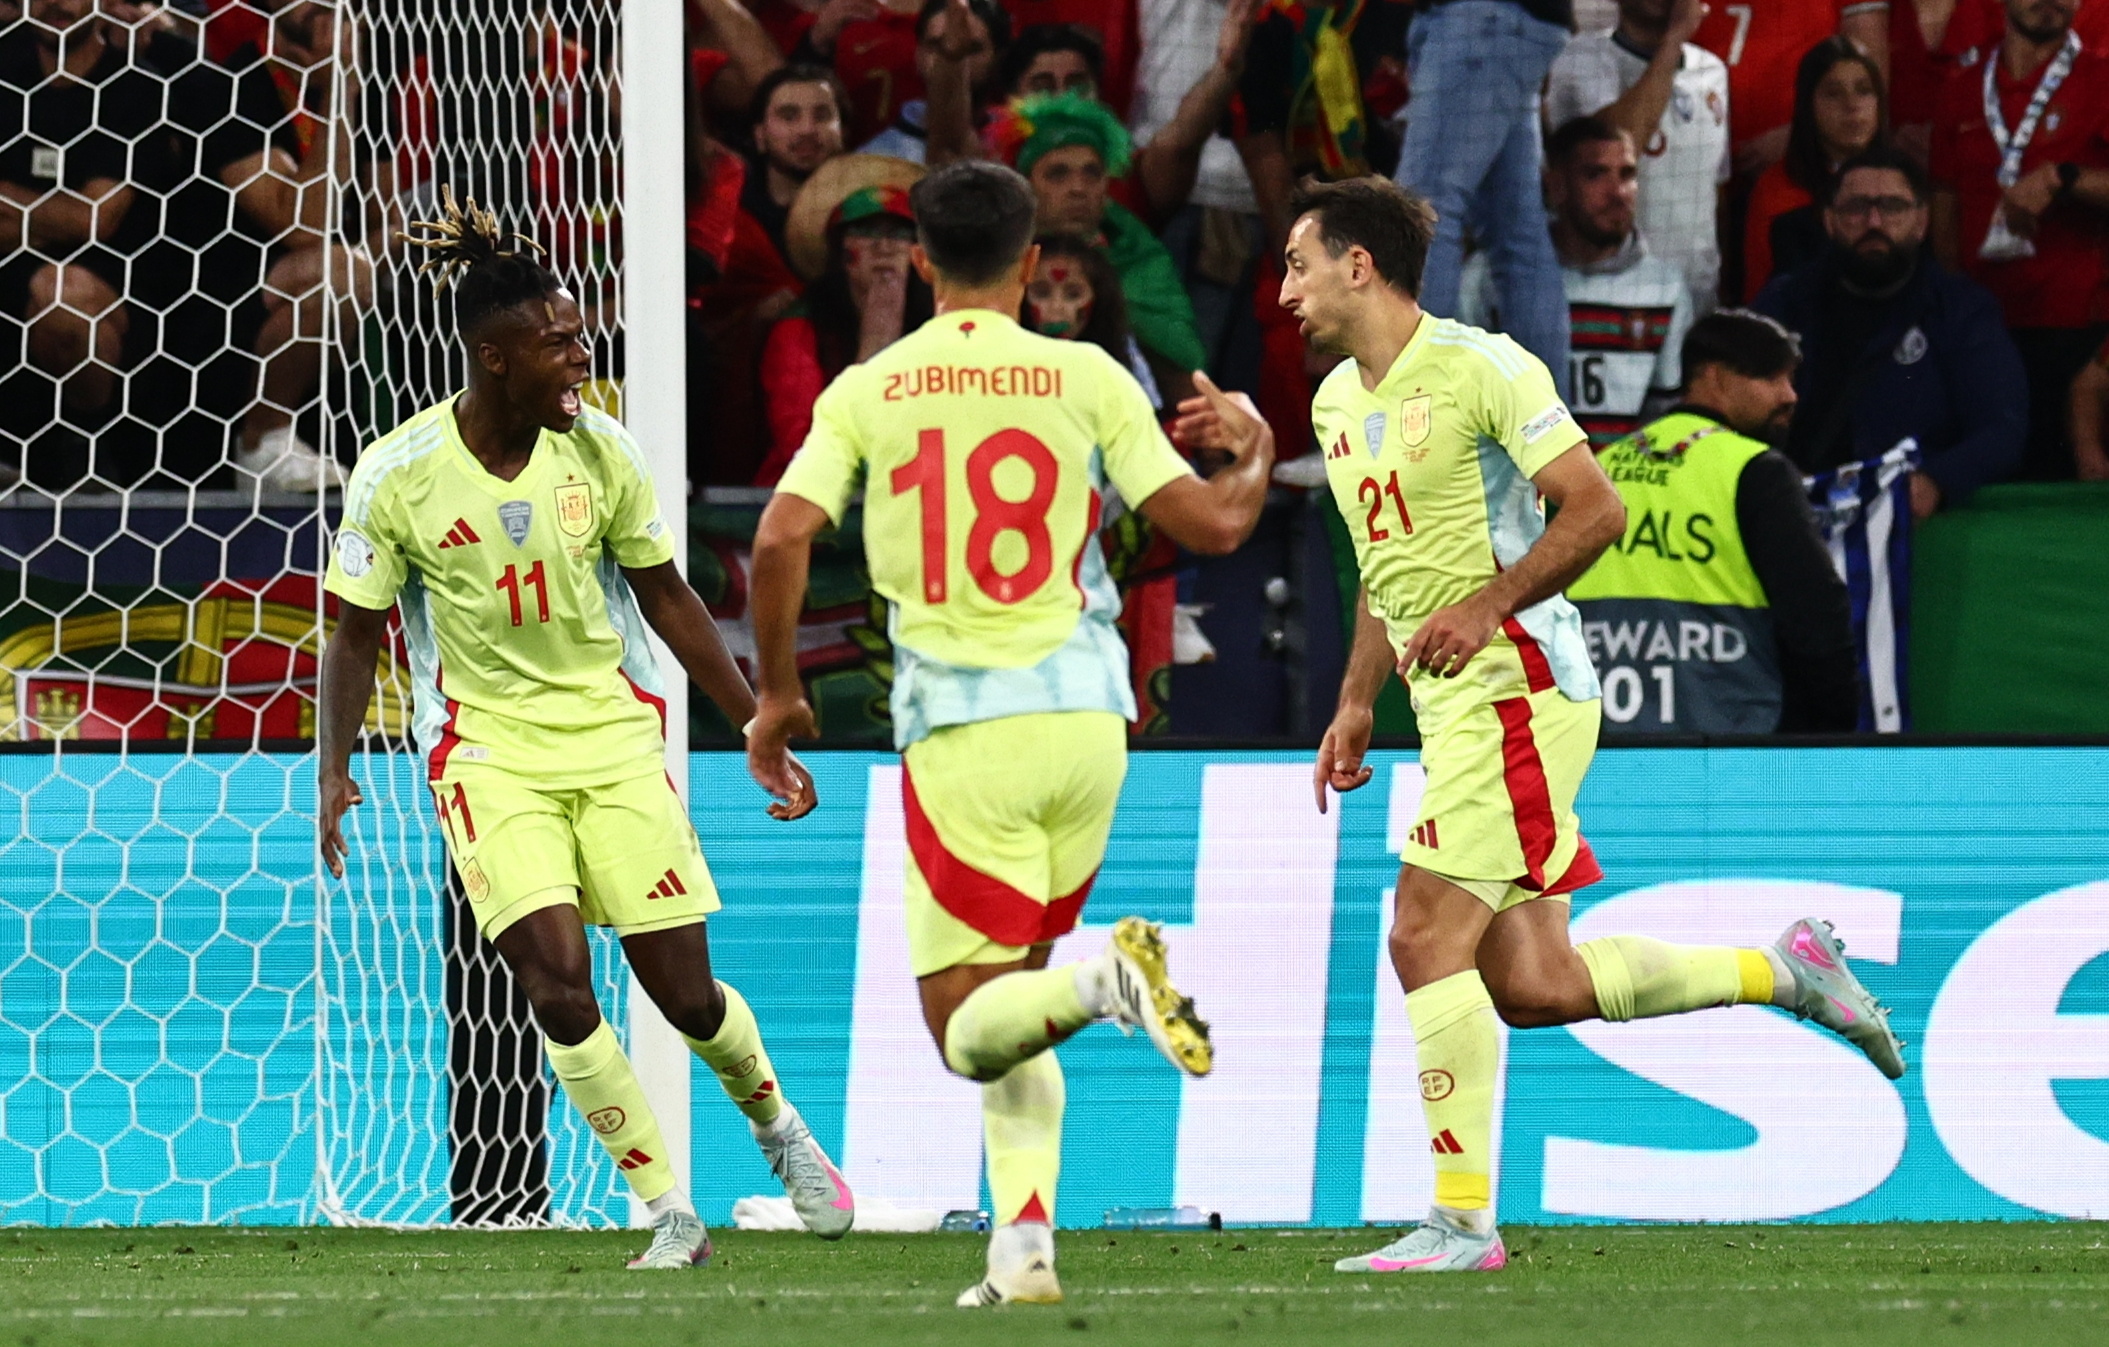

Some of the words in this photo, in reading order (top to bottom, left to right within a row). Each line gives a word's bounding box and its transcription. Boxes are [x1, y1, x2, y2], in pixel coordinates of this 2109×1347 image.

[1726, 4, 1751, 66] 7
[865, 67, 893, 120] 7
[884, 365, 1062, 402] ZUBIMENDI
[1568, 357, 1606, 406] 16
[1358, 469, 1414, 543] 21
[1611, 466, 1670, 487] LEAGUE
[889, 427, 1060, 605] 18
[1612, 510, 1716, 564] ALS
[495, 560, 550, 627] 11
[1596, 665, 1676, 724] 01
[439, 781, 477, 855] 11
